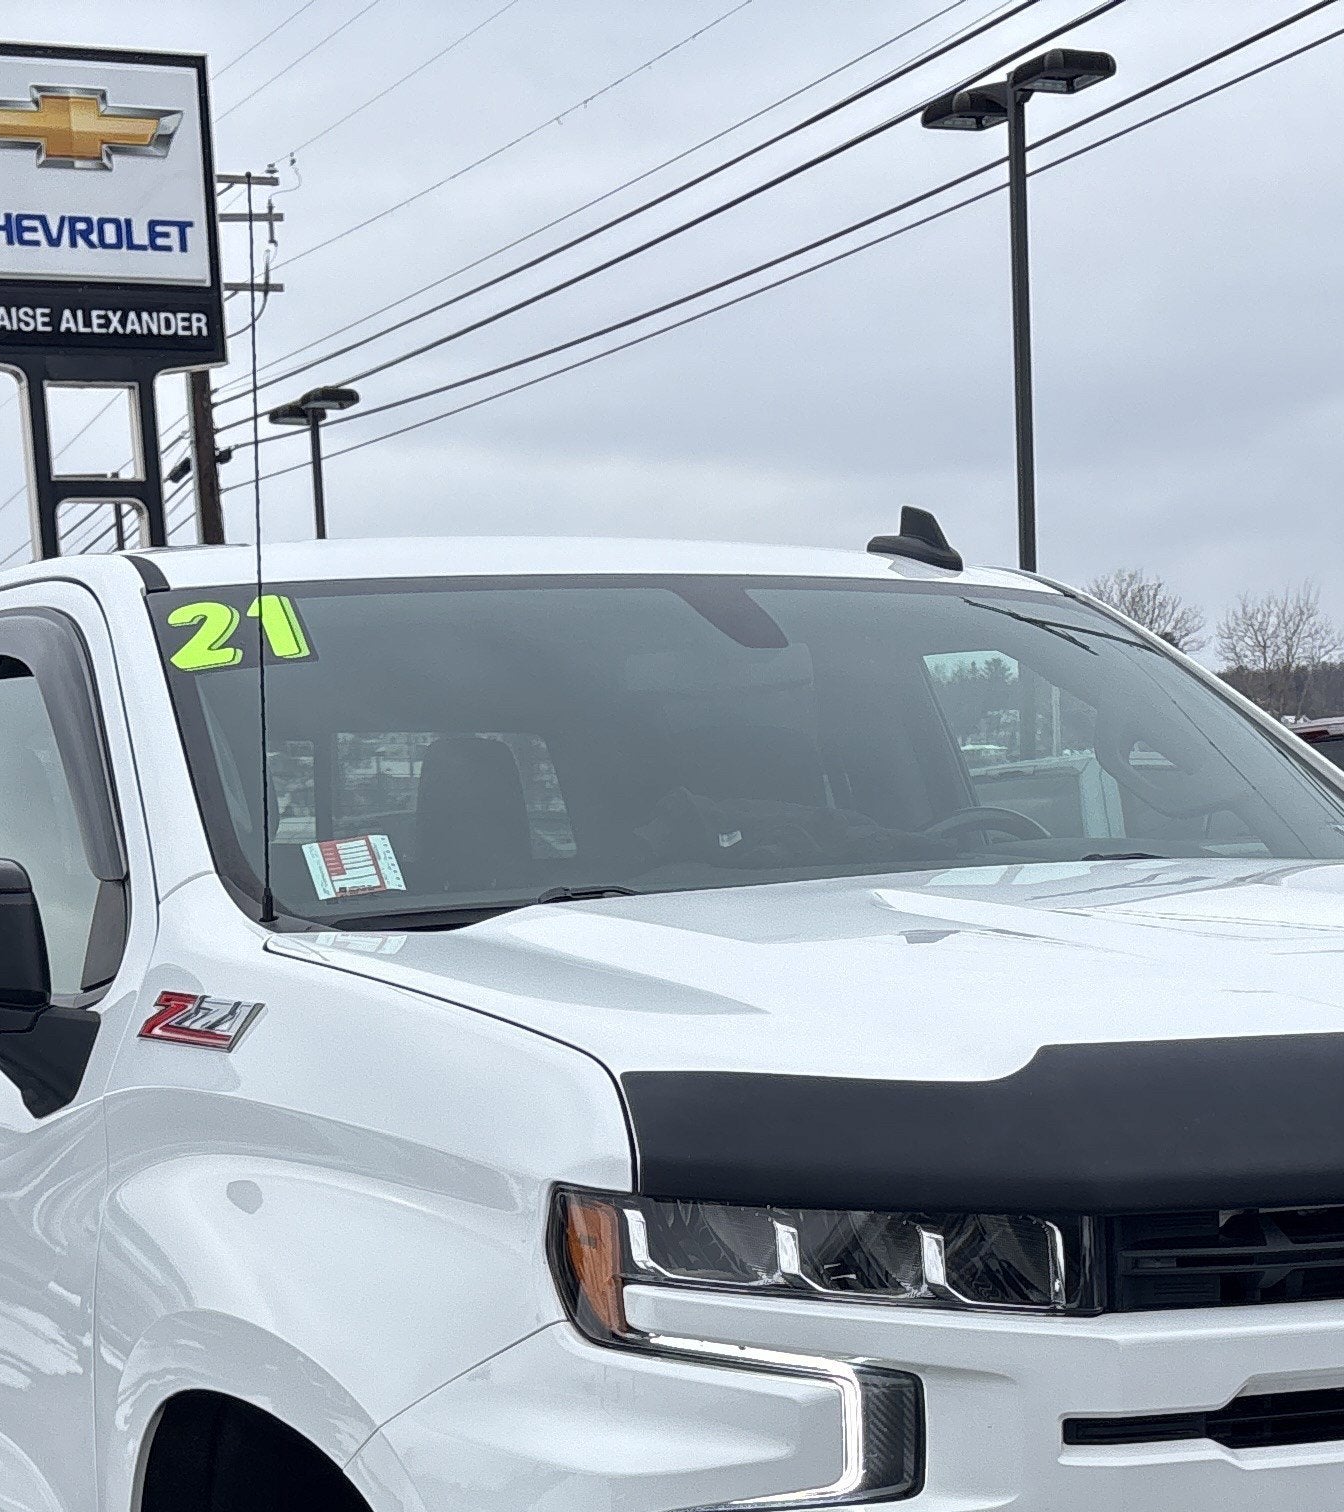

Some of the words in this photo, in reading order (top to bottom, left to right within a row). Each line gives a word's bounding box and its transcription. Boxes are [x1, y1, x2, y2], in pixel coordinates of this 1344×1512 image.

[59, 309, 208, 336] ALEXANDER
[167, 594, 311, 672] 21
[137, 990, 267, 1053] Z71
